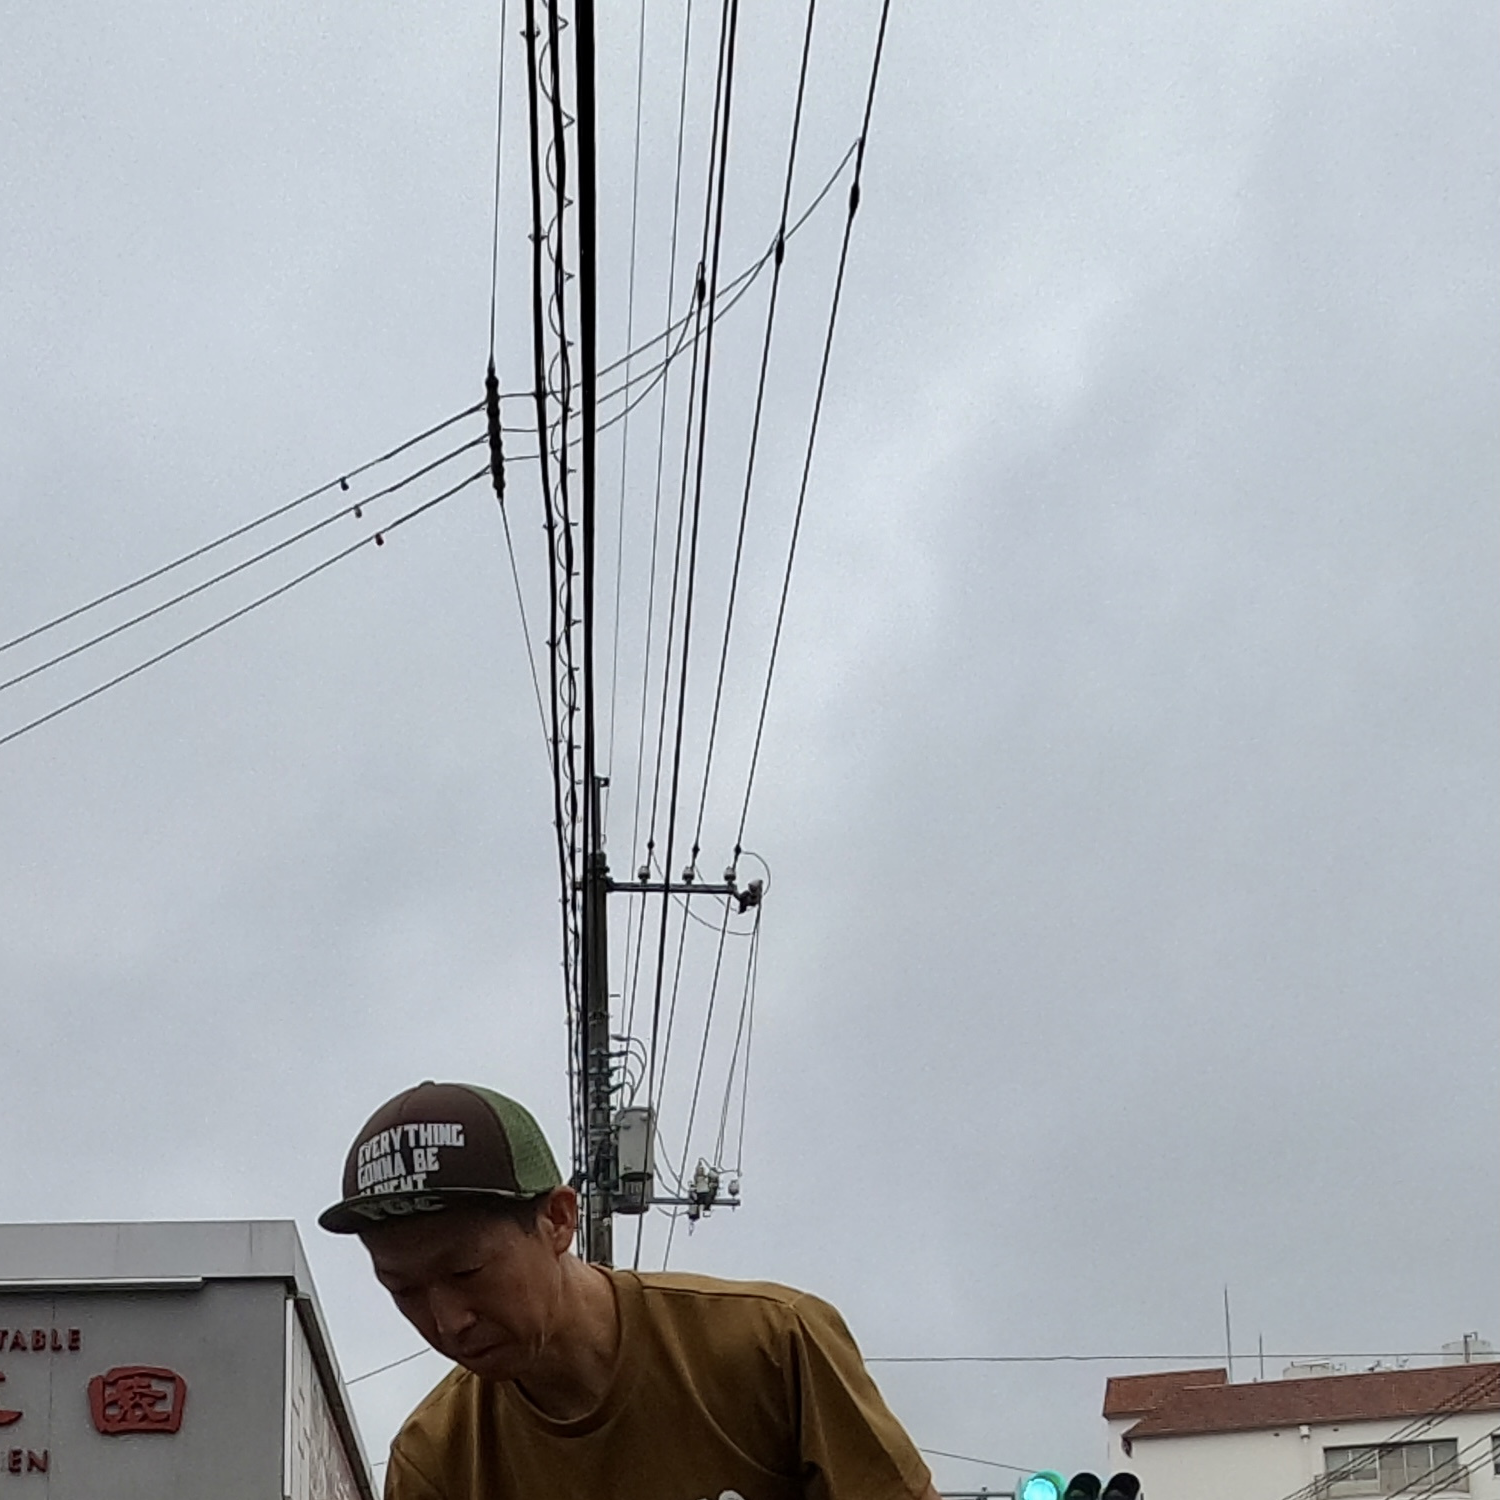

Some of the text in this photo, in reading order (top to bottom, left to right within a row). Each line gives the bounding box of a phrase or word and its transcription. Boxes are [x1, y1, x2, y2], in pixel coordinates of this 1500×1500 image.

[357, 1122, 465, 1168] EVERYTHING
[357, 1147, 440, 1191] GONNA BE
[8, 1448, 50, 1476] EN
